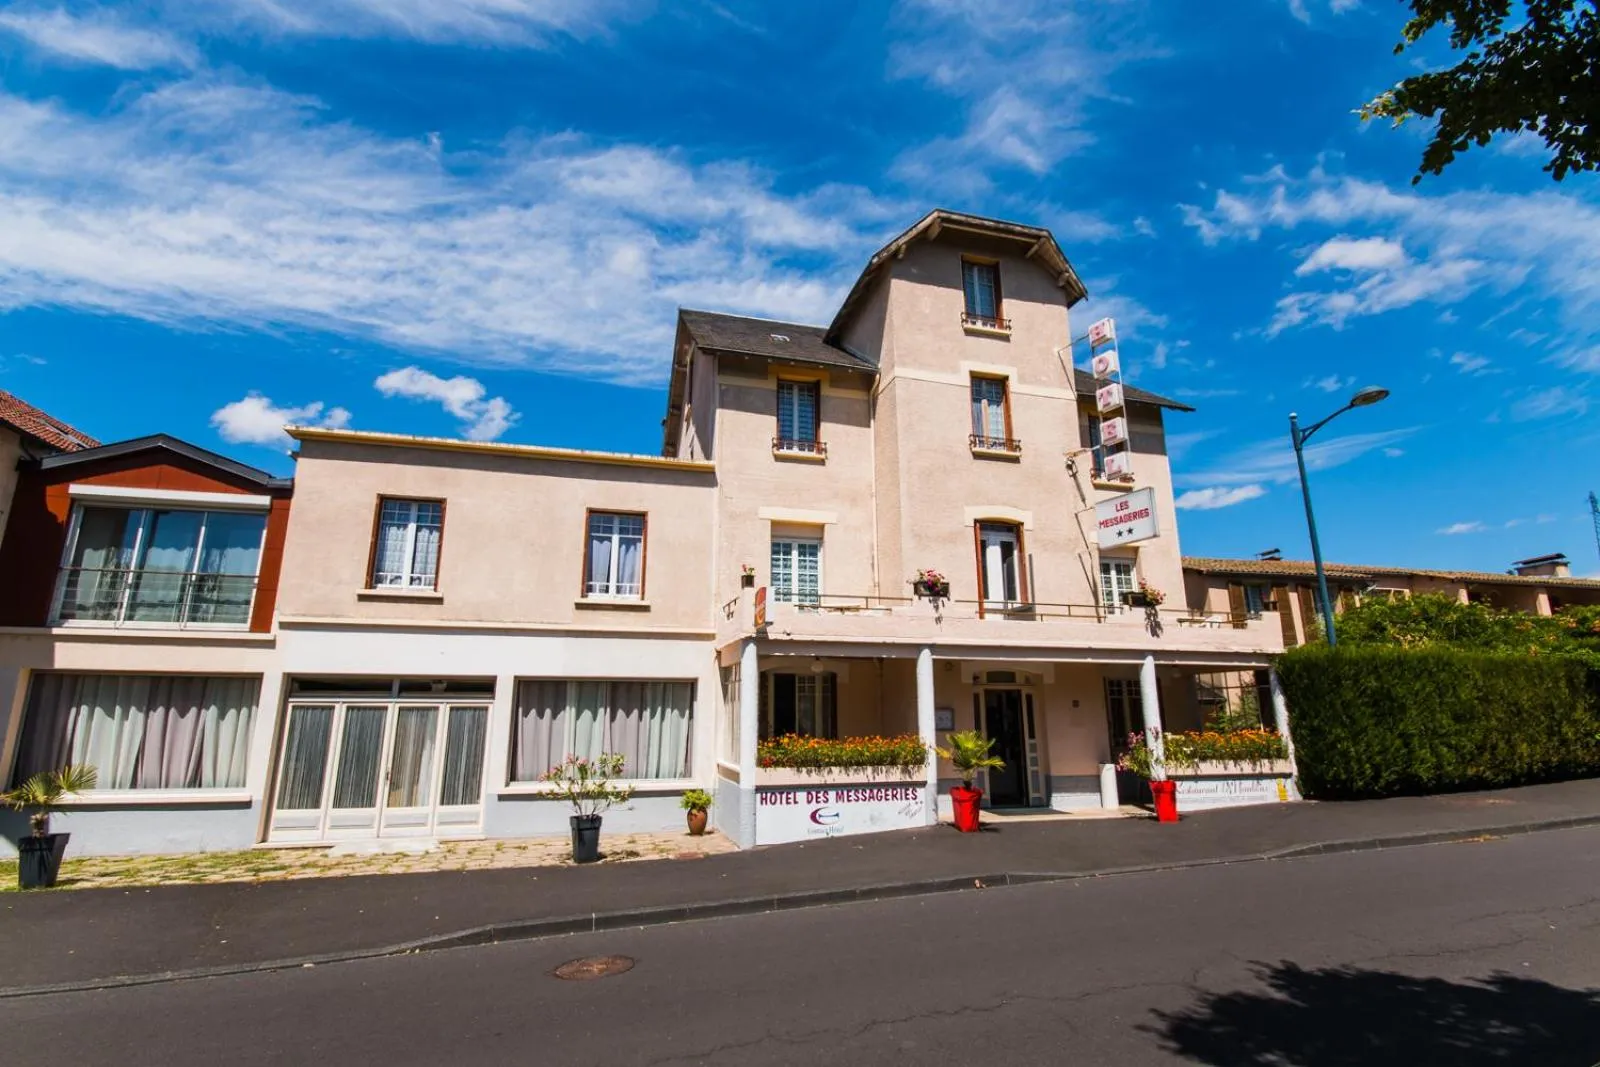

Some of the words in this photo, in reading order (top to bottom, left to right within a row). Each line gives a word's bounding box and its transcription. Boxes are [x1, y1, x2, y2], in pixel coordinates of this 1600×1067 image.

[1089, 321, 1123, 476] HOTEL
[1115, 500, 1129, 512] LES
[1098, 508, 1150, 529] MESSAGERIES
[760, 791, 799, 806] HOTEL
[806, 790, 829, 804] DES
[835, 787, 918, 804] MESSAGERIES
